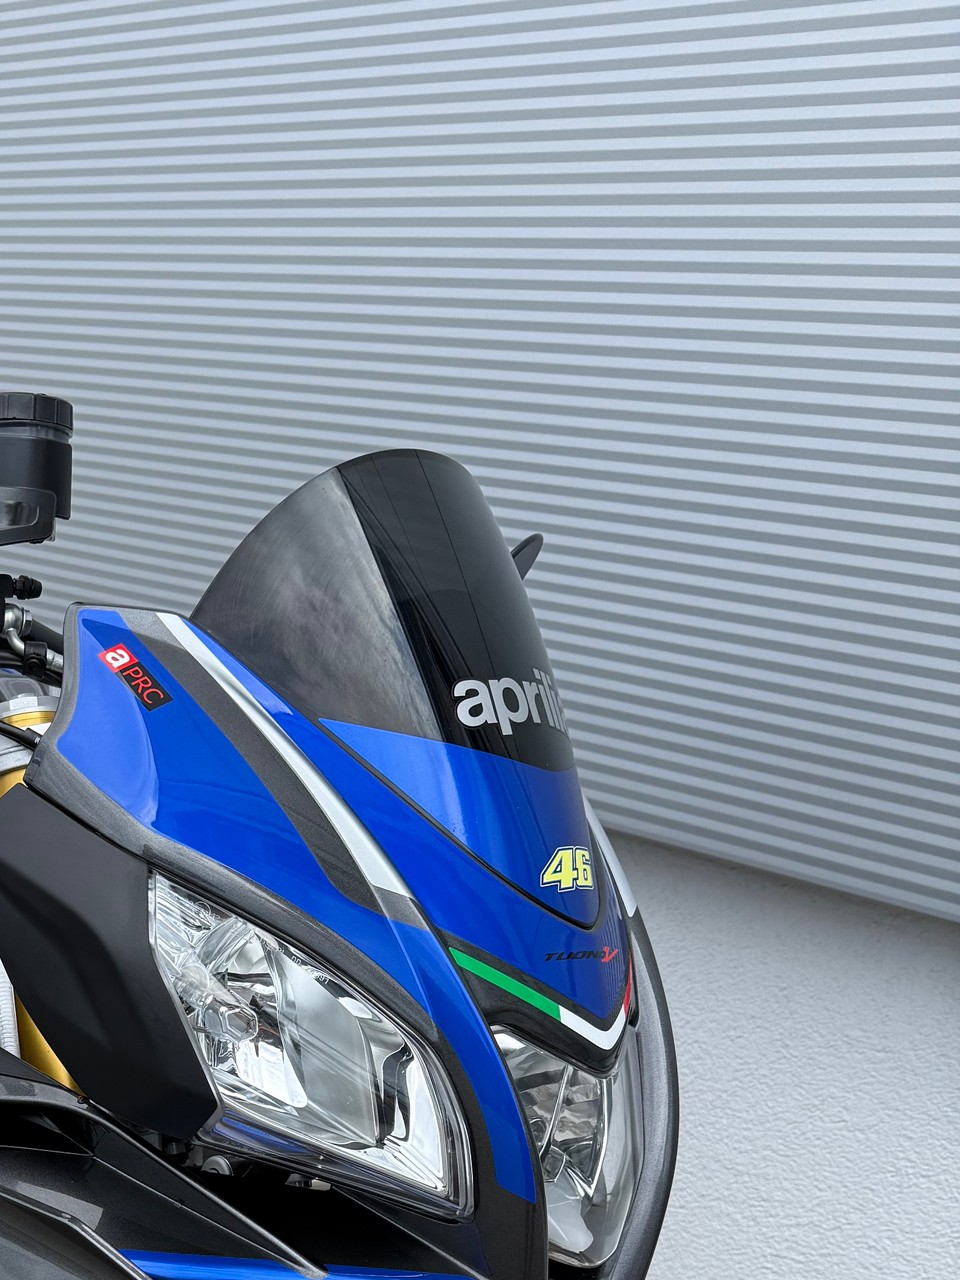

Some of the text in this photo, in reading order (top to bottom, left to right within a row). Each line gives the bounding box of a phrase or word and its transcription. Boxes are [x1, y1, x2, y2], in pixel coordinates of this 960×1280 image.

[122, 666, 164, 704] PRC
[453, 667, 570, 736] aprili
[540, 846, 594, 893] 46
